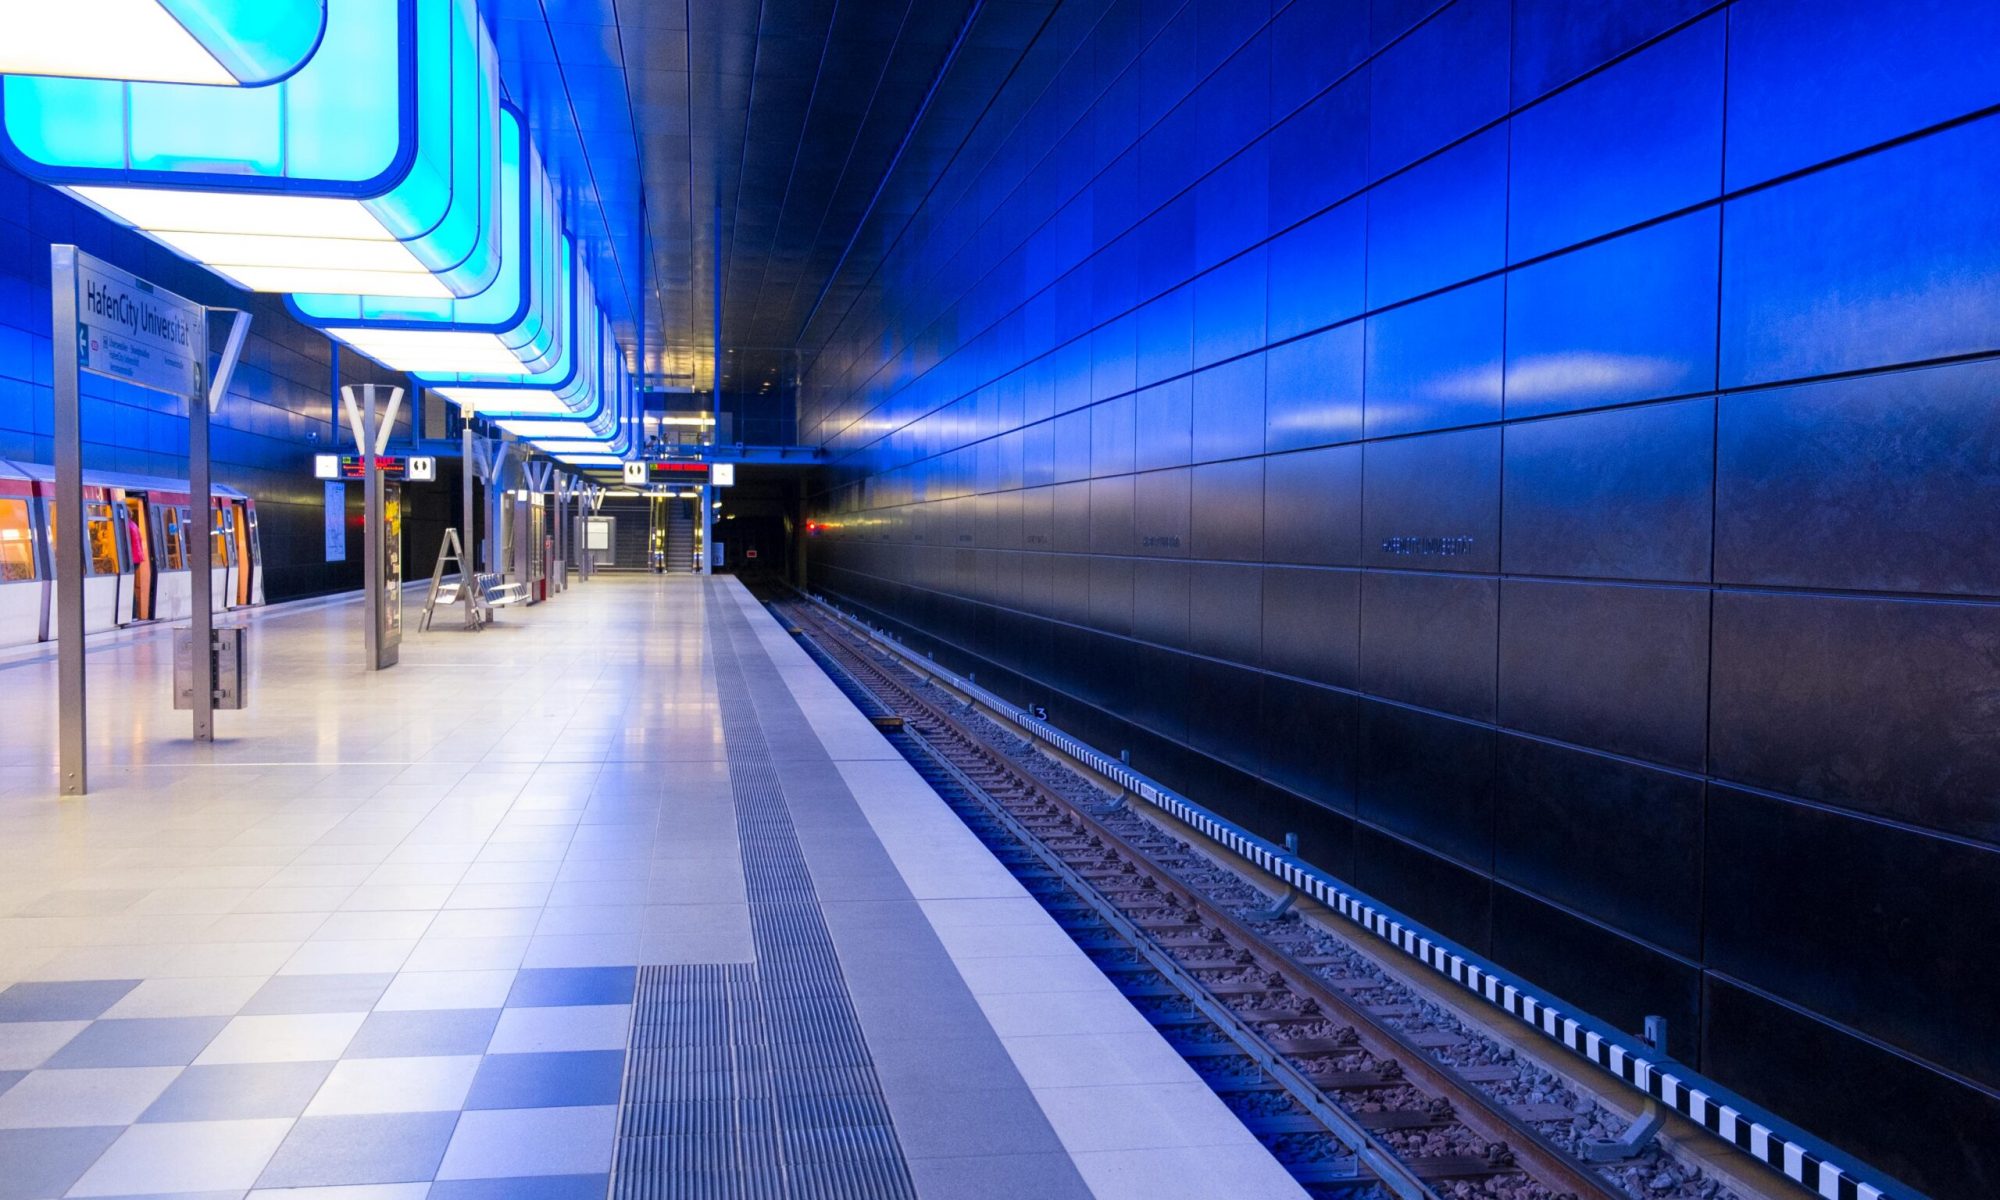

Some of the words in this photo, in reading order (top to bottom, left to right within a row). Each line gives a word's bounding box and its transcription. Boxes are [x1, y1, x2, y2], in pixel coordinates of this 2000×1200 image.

[87, 279, 139, 336] HafenCity
[141, 301, 190, 347] Universität
[1035, 707, 1047, 721] 3
